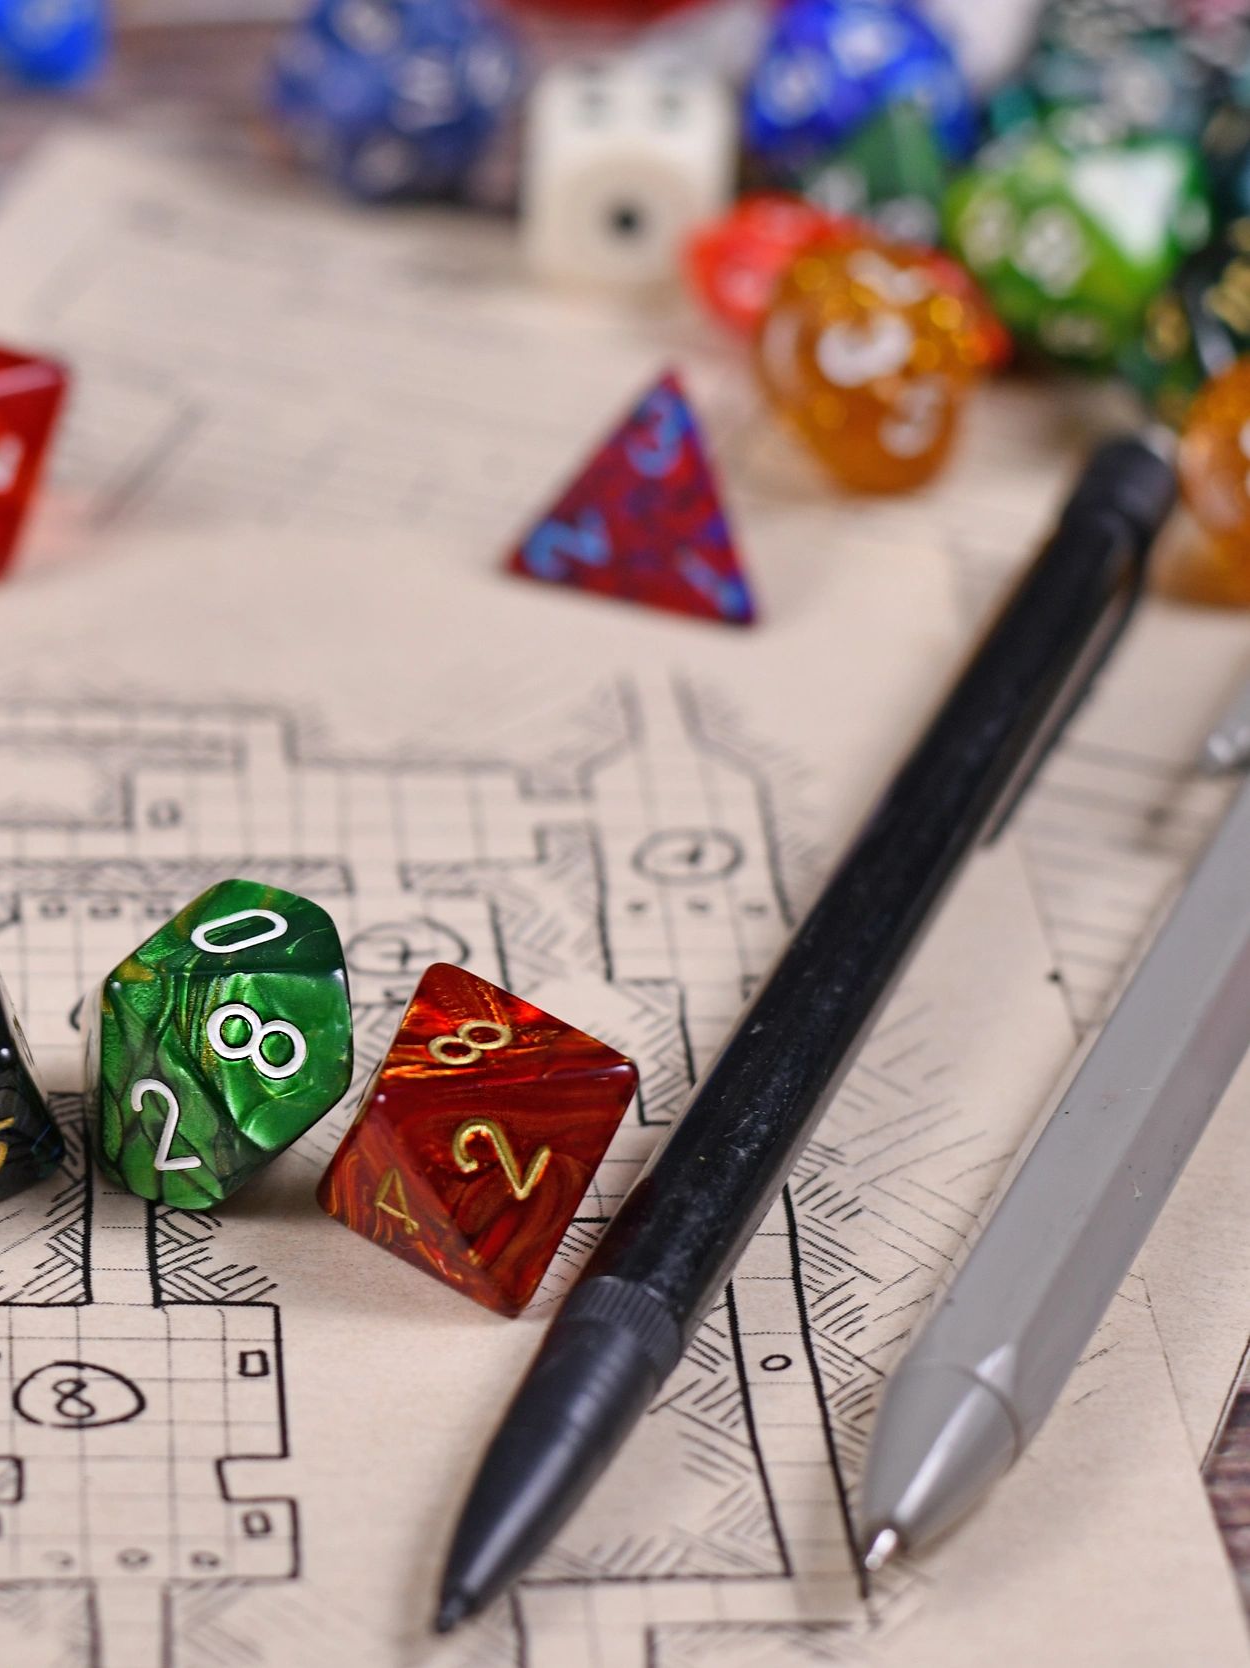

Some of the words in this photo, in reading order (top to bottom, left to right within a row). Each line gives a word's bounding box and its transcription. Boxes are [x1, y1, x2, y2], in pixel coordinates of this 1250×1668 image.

[190, 907, 289, 954] 0
[205, 1001, 308, 1080] 8
[427, 1018, 514, 1065] 8
[130, 1077, 203, 1172] 2
[452, 1116, 552, 1200] 2
[374, 1167, 420, 1234] 4
[52, 1377, 96, 1419] 8
